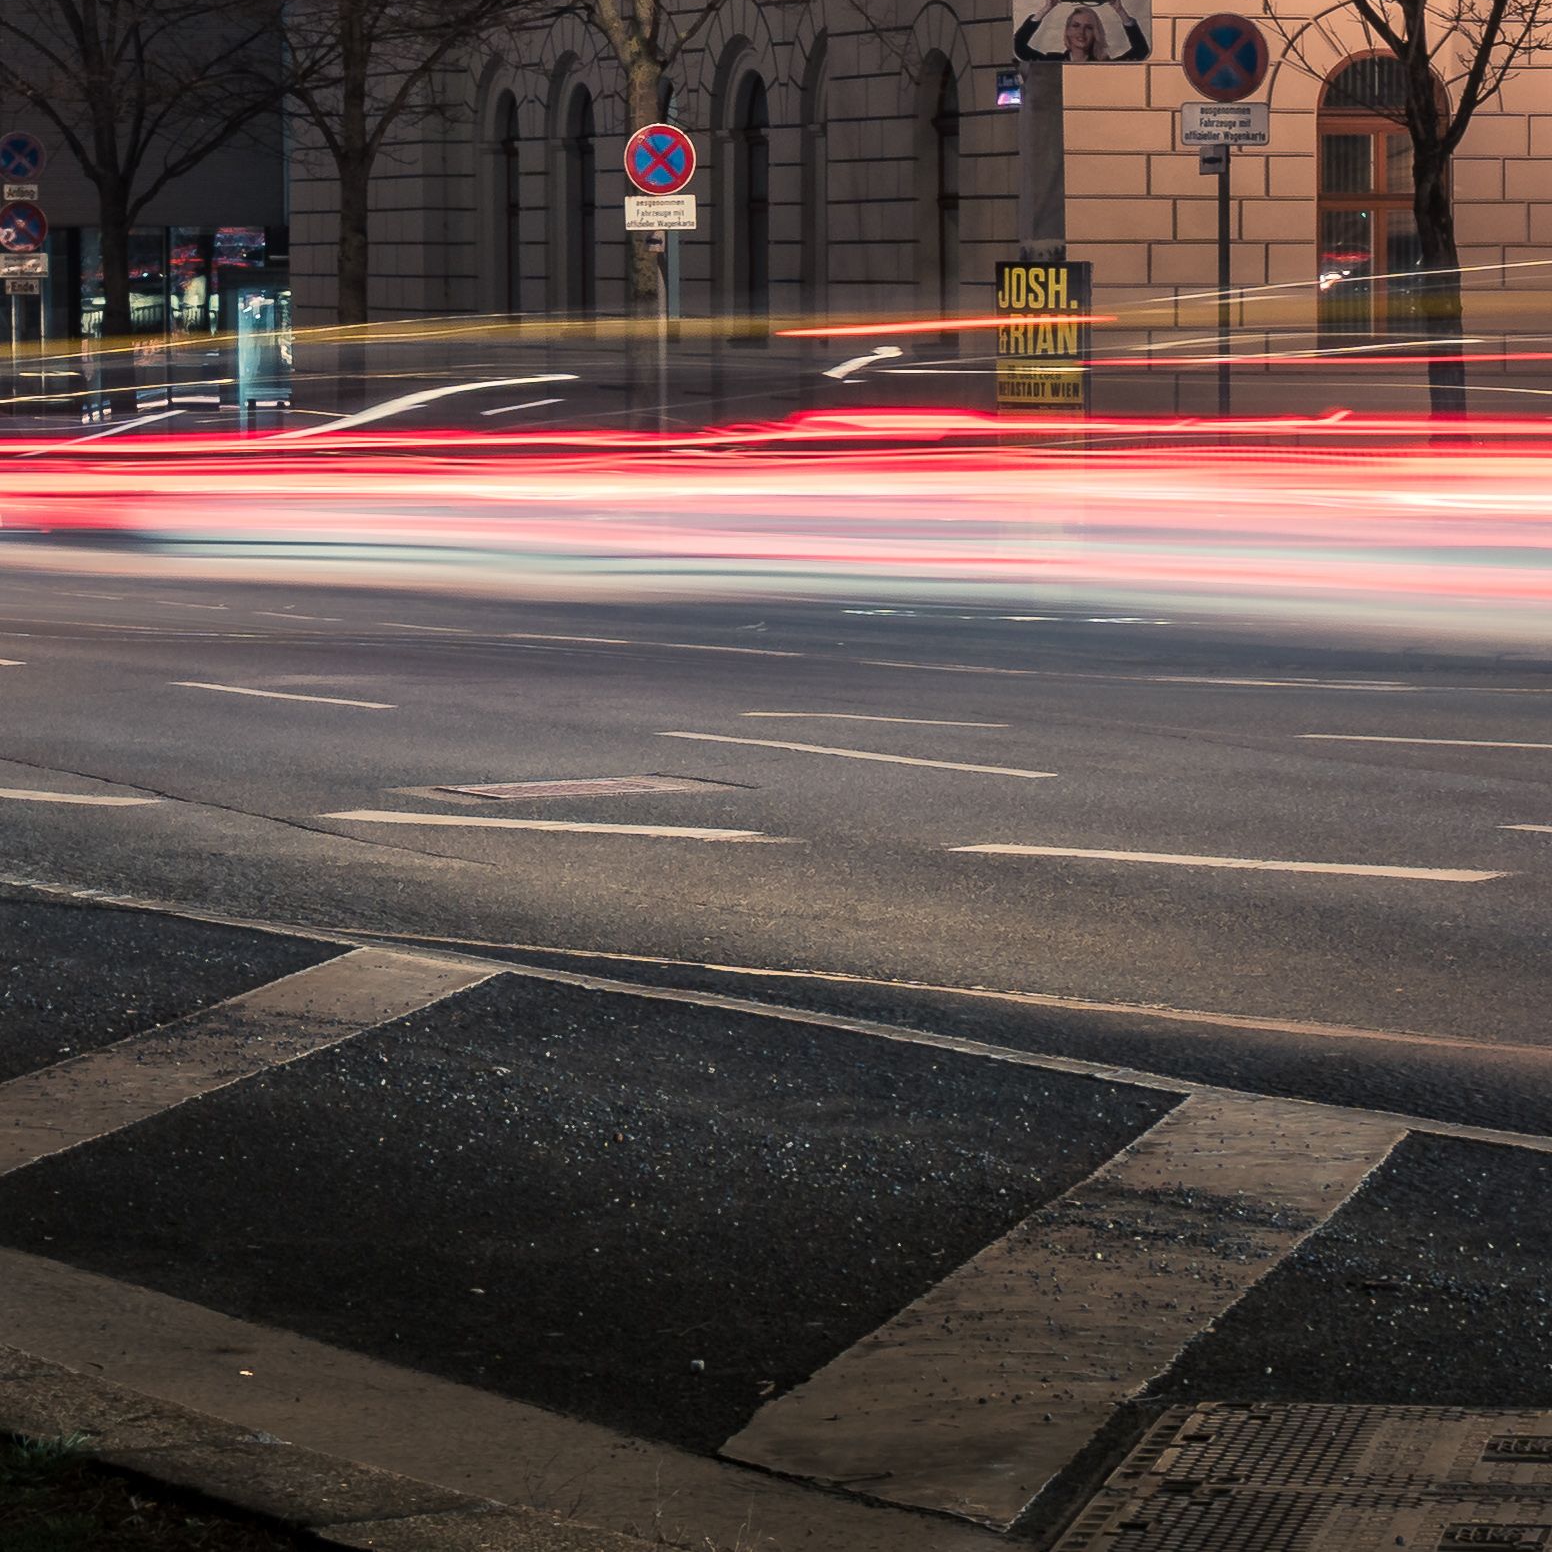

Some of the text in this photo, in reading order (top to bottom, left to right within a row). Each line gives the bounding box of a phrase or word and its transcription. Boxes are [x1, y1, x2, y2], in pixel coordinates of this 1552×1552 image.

[998, 267, 1078, 309] JOSH.
[1010, 313, 1078, 355] RIAN
[1050, 381, 1080, 398] WIEN
